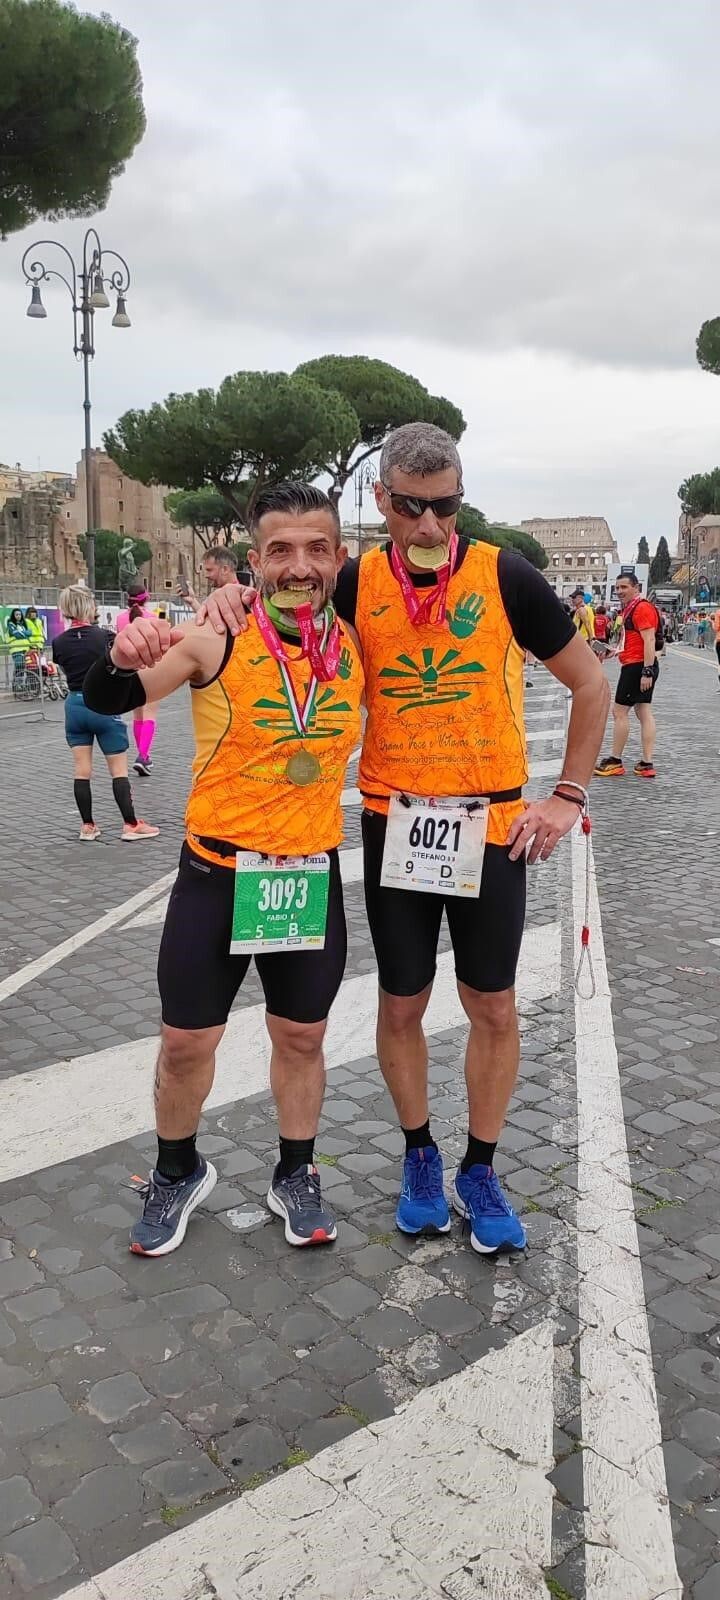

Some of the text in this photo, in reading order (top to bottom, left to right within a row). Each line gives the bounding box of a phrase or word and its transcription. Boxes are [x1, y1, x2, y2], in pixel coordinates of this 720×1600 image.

[409, 816, 462, 852] 6021
[302, 856, 327, 866] Joma
[412, 852, 446, 862] STEFANO
[404, 861, 414, 874] 9
[440, 865, 452, 878] D
[258, 878, 309, 912] 3093
[266, 914, 288, 922] FABIO
[255, 925, 264, 938] 5
[288, 923, 298, 937] B
